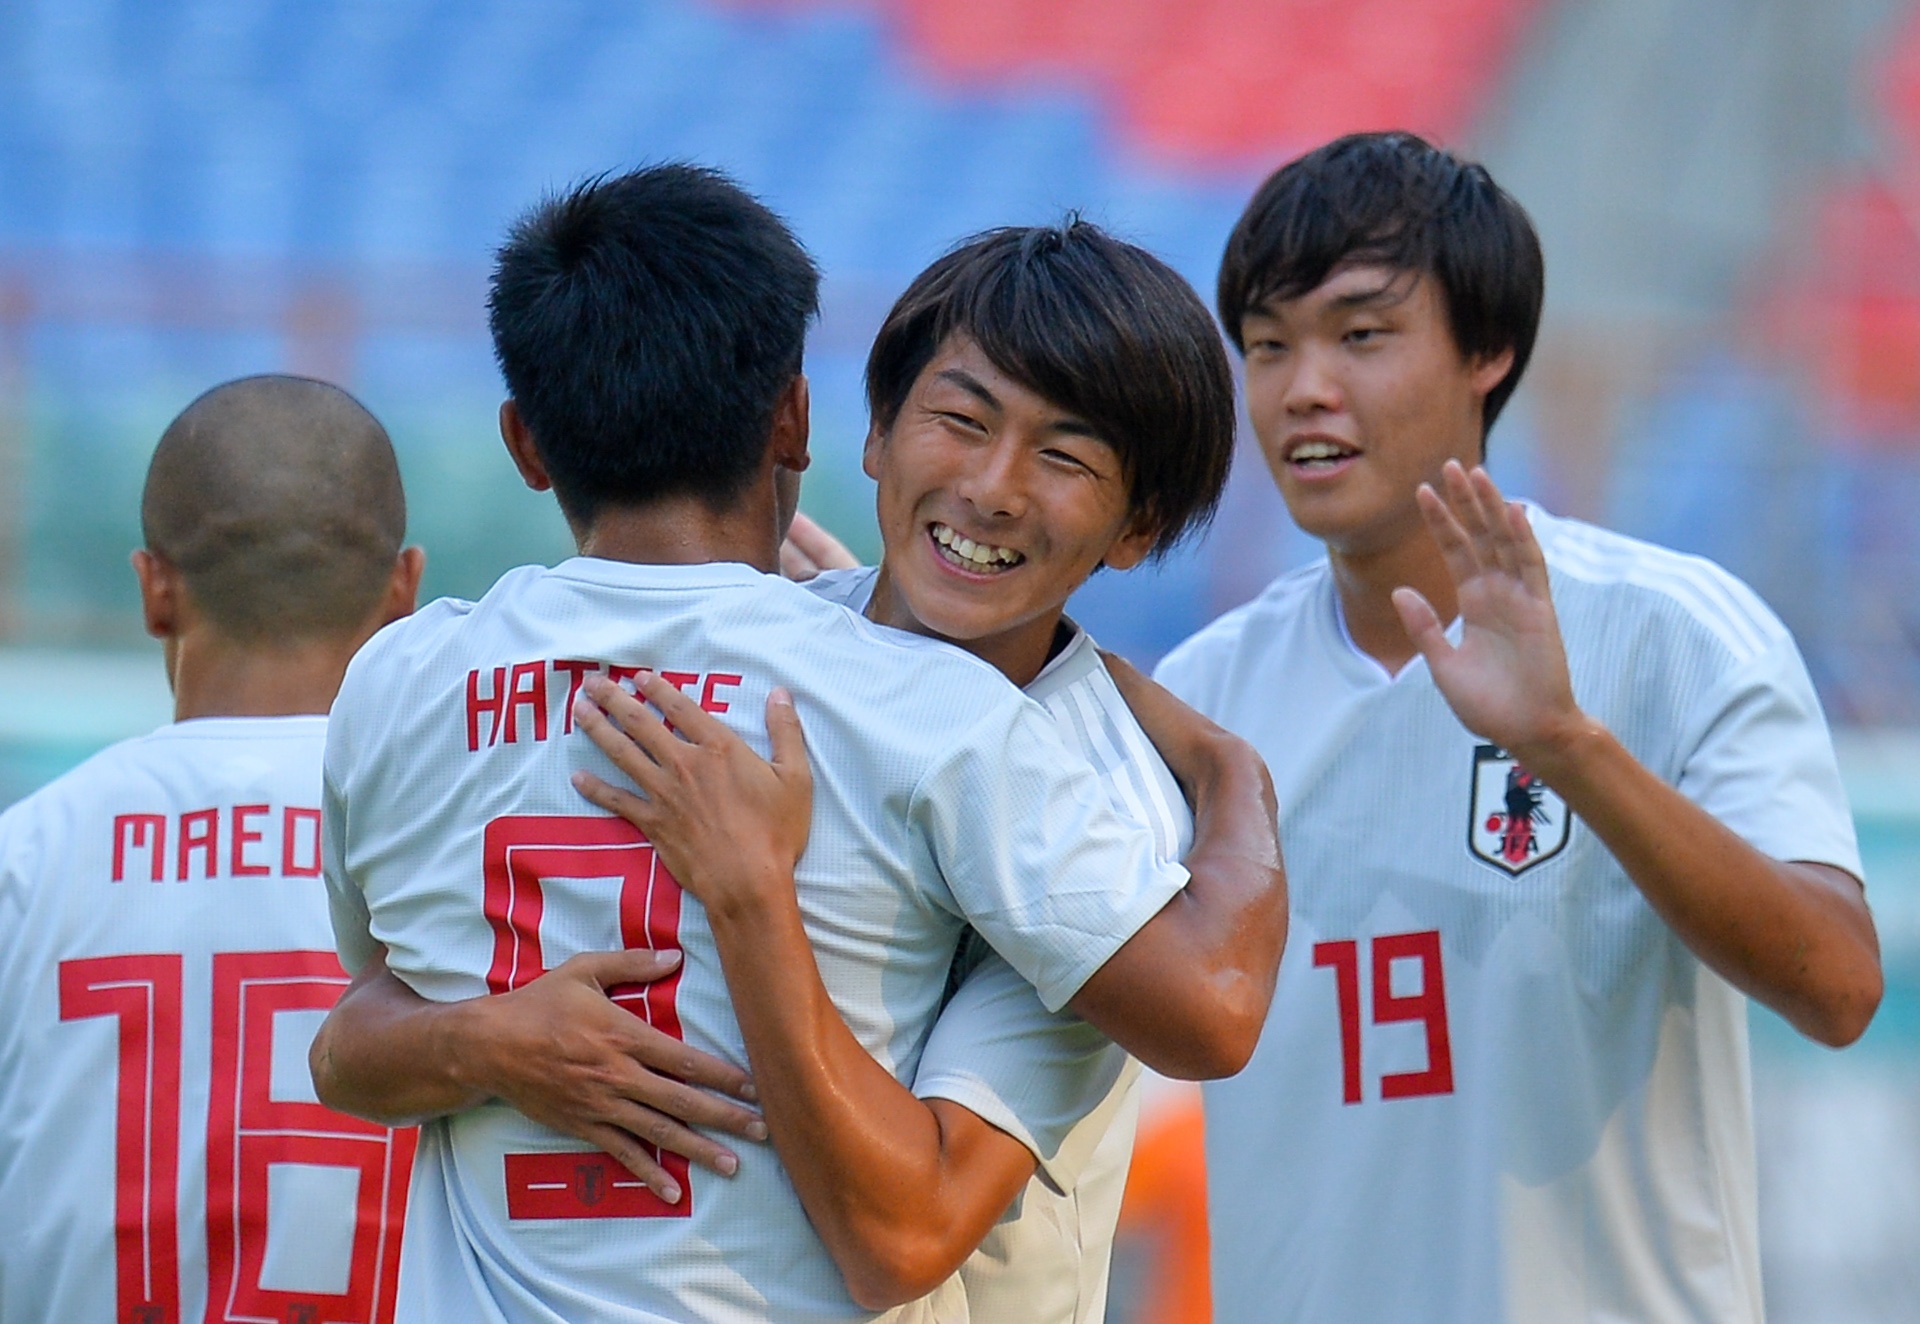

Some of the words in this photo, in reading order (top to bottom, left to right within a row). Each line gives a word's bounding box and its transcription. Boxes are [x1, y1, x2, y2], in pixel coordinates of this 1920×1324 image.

[1493, 834, 1539, 854] JFA
[1313, 930, 1454, 1106] 19
[58, 950, 422, 1324] 18
